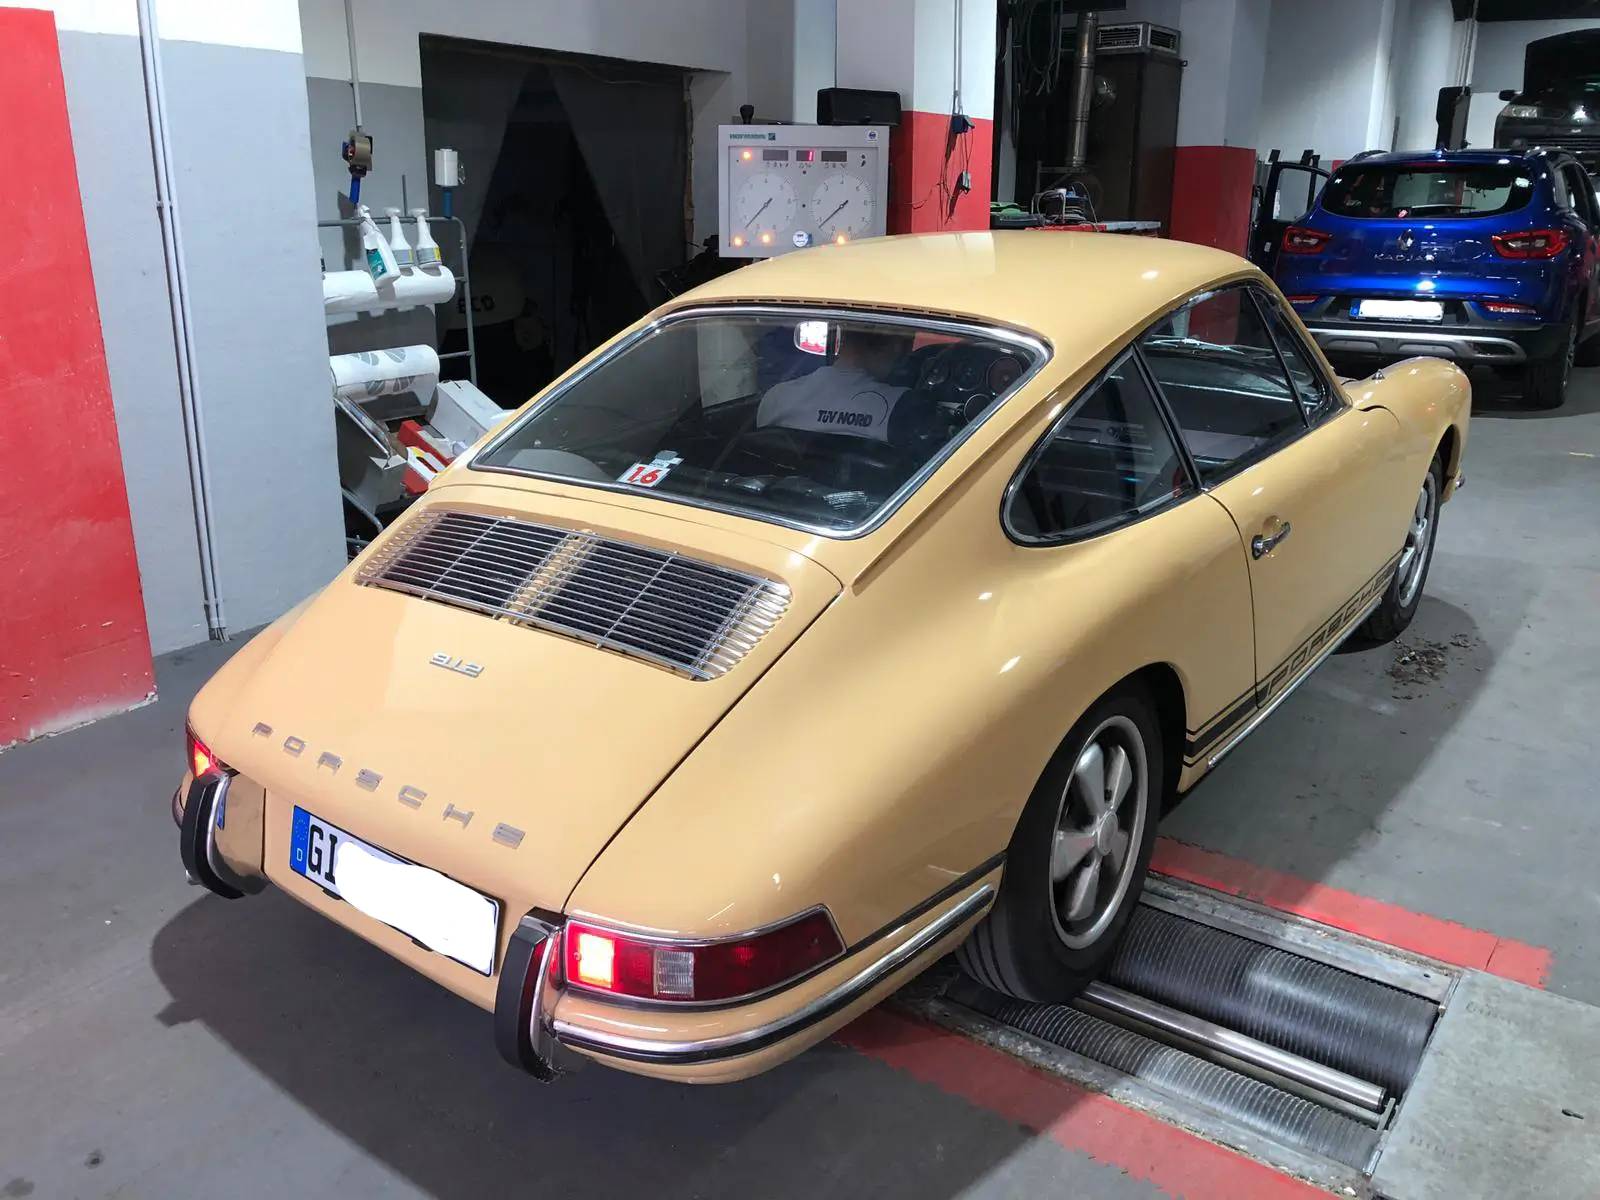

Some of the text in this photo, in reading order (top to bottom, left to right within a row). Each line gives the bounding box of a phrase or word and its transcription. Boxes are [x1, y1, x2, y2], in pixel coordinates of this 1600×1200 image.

[837, 411, 873, 427] NORD
[627, 466, 662, 484] 16
[429, 652, 485, 678] 912
[252, 721, 526, 850] PORSCHE
[296, 824, 338, 885] D GI
